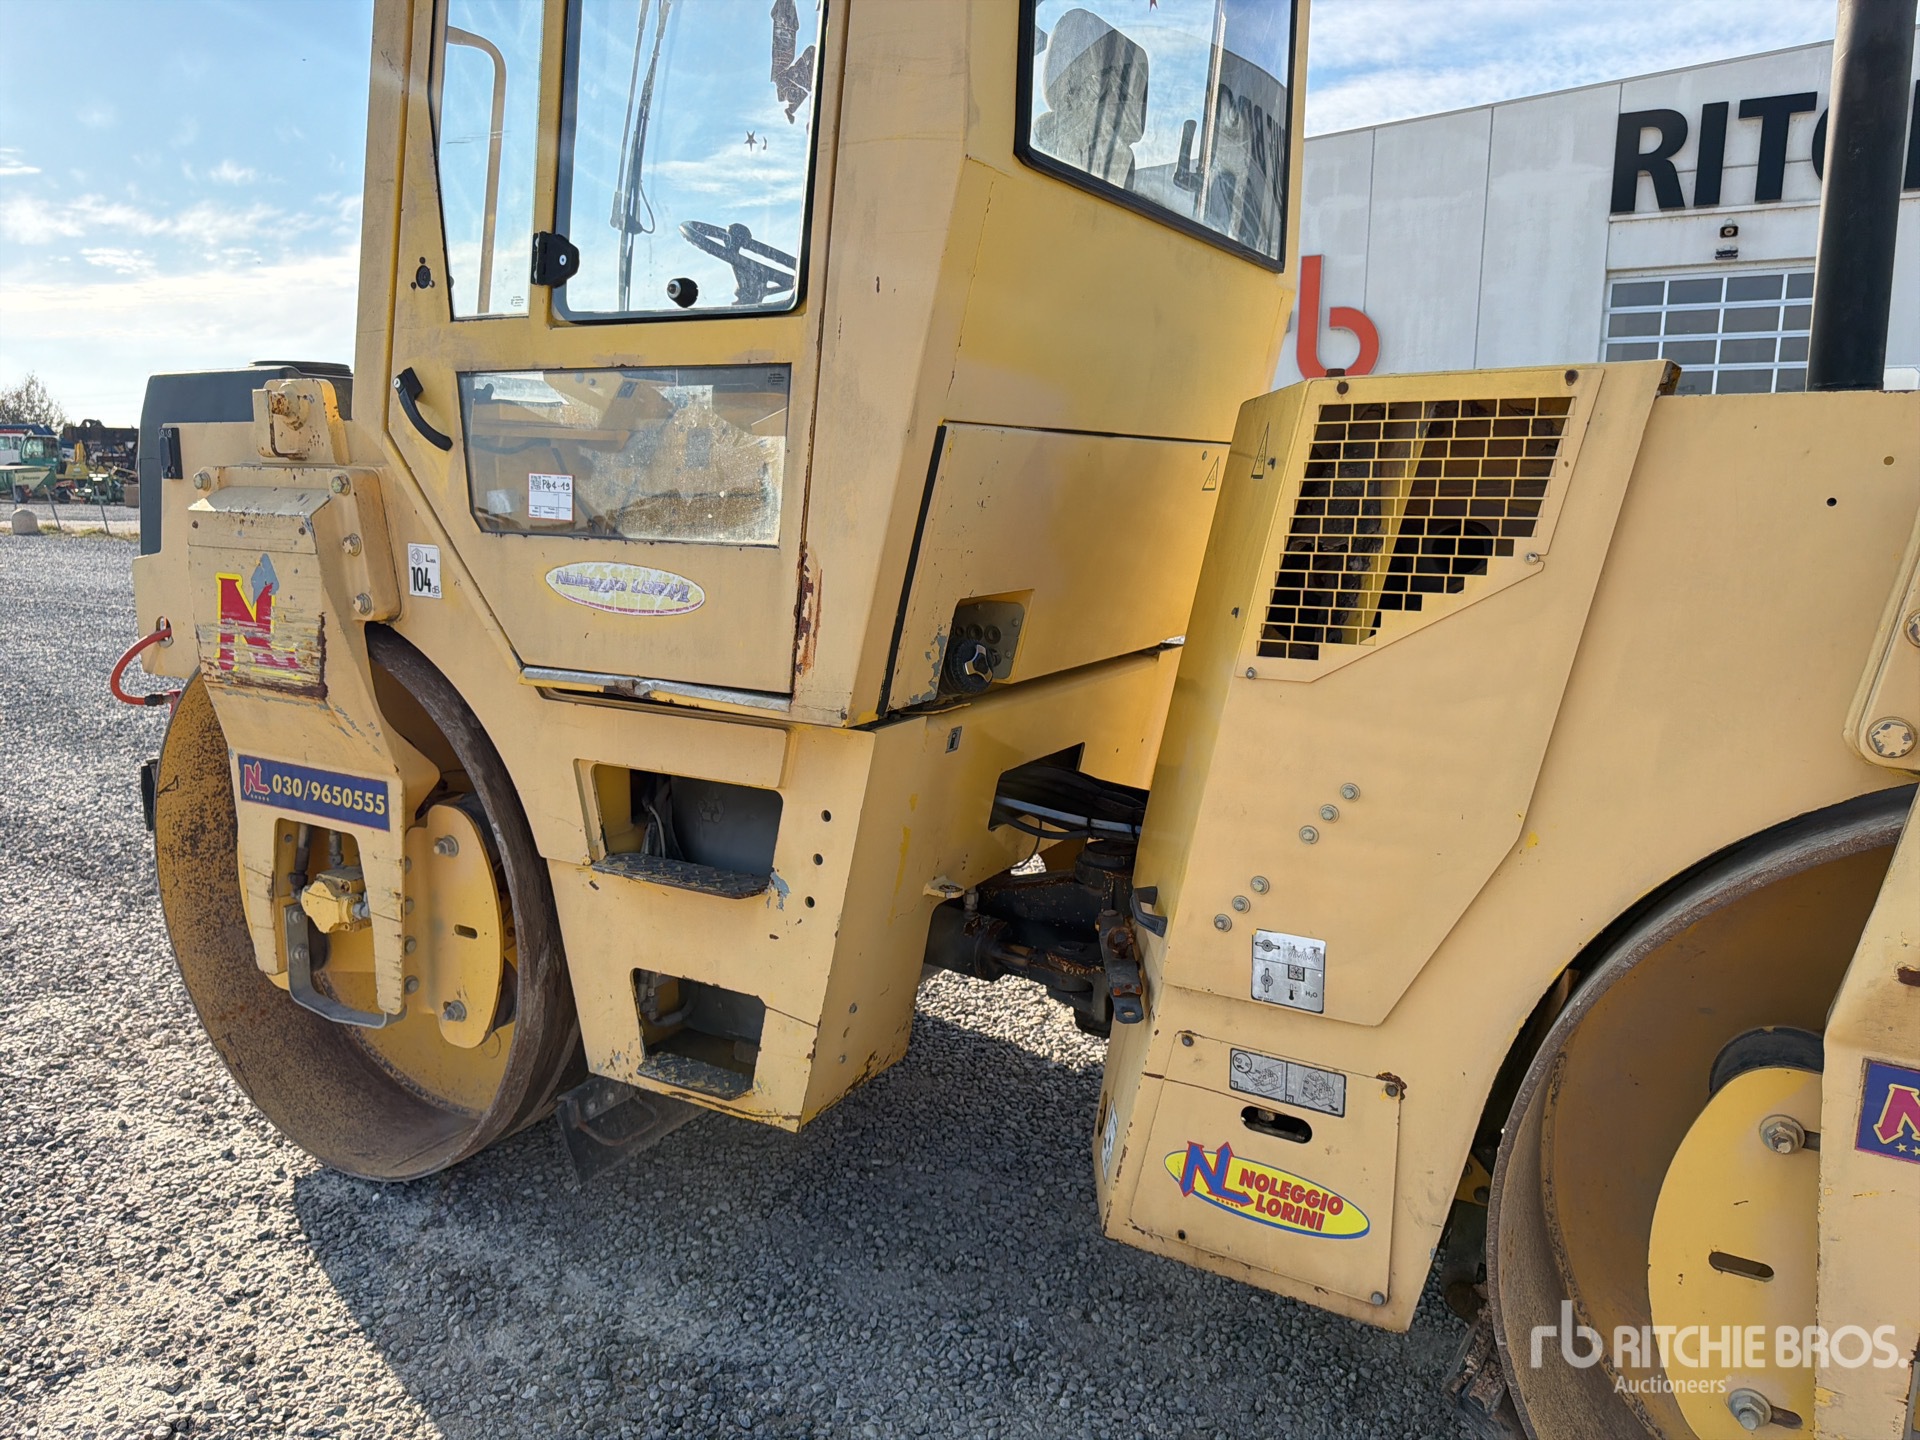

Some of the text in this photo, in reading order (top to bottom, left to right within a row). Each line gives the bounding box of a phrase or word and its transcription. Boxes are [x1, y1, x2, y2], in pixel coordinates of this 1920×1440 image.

[1611, 80, 1920, 214] RIT
[1288, 254, 1381, 379] b
[411, 566, 431, 593] 104
[272, 774, 386, 815] 030/9650555
[1238, 1168, 1344, 1216] NOLEGGIO
[1254, 1194, 1326, 1232] LORINI
